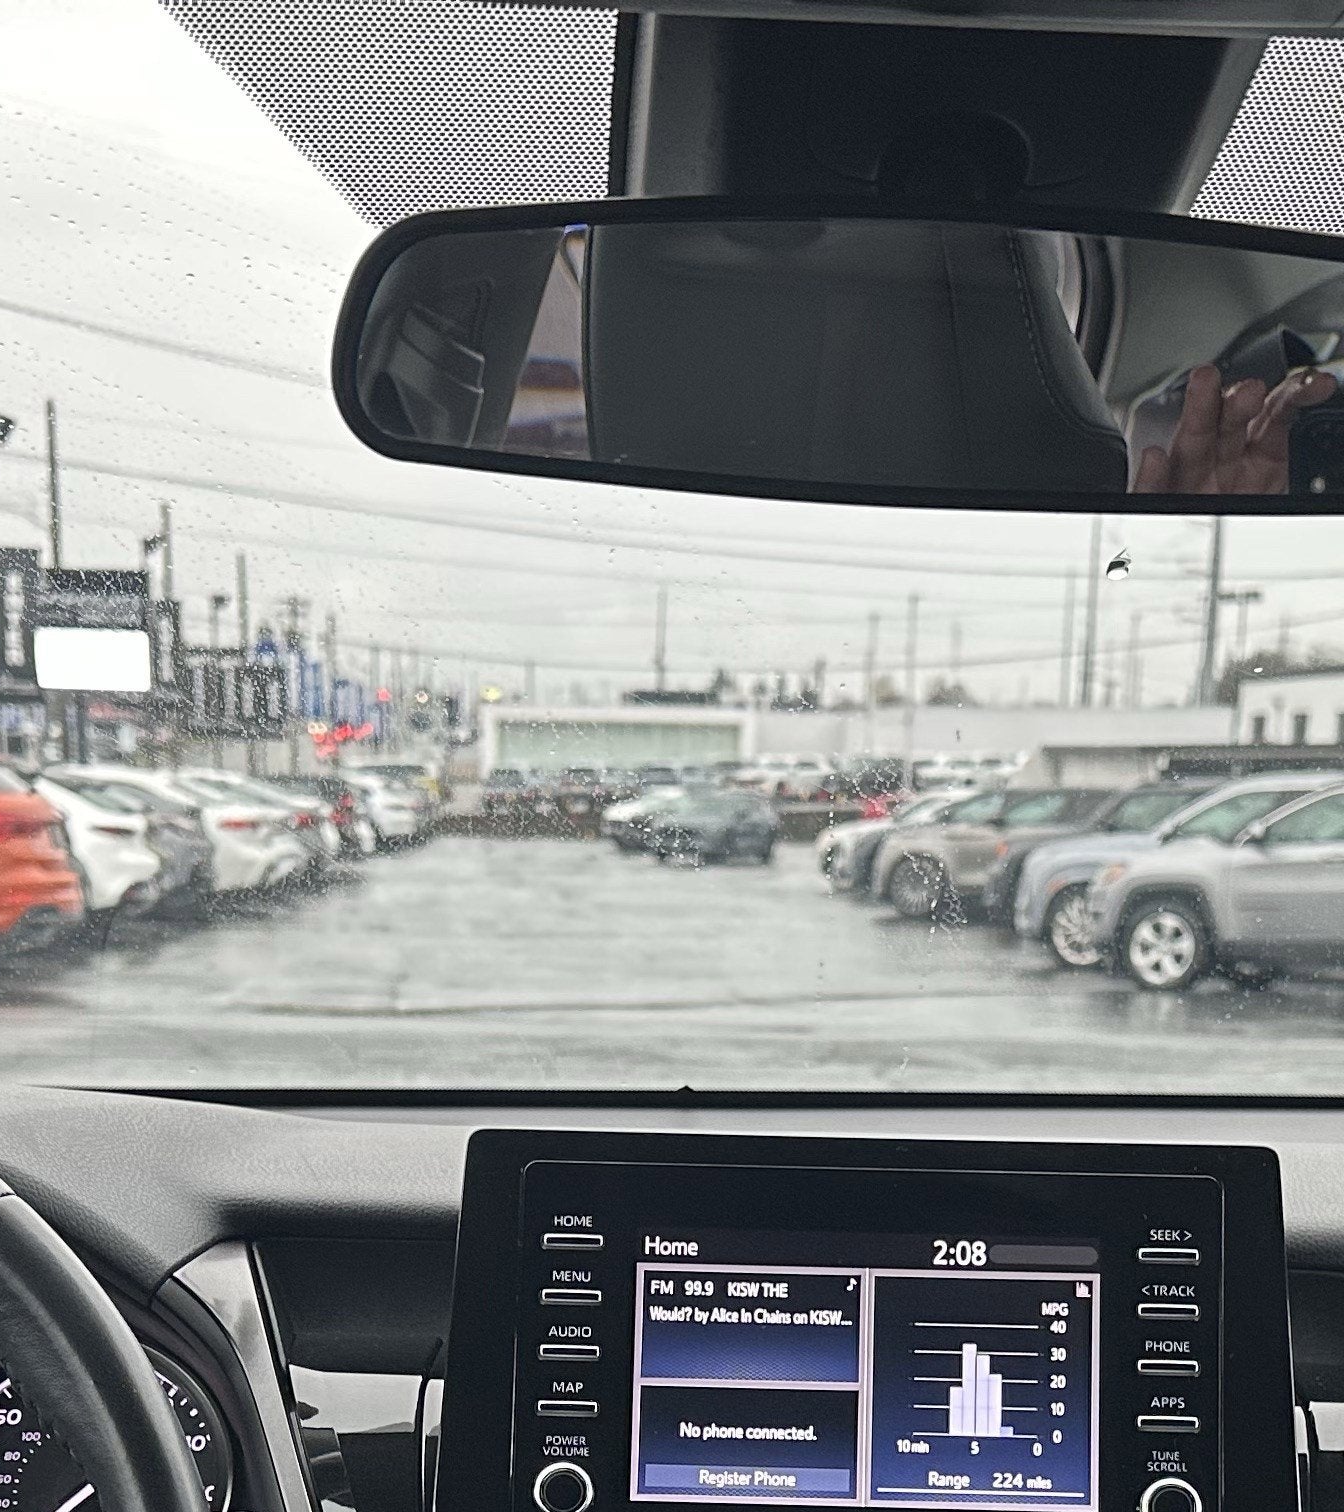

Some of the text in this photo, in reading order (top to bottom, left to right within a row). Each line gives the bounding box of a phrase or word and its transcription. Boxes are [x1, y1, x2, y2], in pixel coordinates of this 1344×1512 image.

[553, 1215, 593, 1227] HOME
[1150, 1230, 1181, 1242] SEEK
[644, 1236, 699, 1256] Home
[932, 1240, 987, 1266] 2:08
[552, 1270, 592, 1282] MENU
[650, 1280, 789, 1298] FM 99.9 KISW THE
[1153, 1285, 1195, 1297] TRACK
[1041, 1302, 1069, 1317] MPG
[649, 1306, 692, 1322] Would?
[694, 1307, 709, 1325] by
[710, 1307, 739, 1324] Alice
[754, 1308, 792, 1325] Chains
[793, 1313, 808, 1326] on
[548, 1326, 592, 1338] AUDIO
[1049, 1320, 1066, 1334] 40
[1145, 1340, 1191, 1352] PHONE
[1049, 1347, 1066, 1361] 30
[552, 1382, 584, 1393] MAP
[1049, 1375, 1066, 1389] 20
[1150, 1397, 1185, 1408] APPS
[1049, 1402, 1066, 1416] 10
[22, 1431, 41, 1443] 100
[679, 1422, 818, 1442] No phone connected.
[1052, 1430, 1063, 1443] 0
[545, 1436, 586, 1446] POWER
[3, 1450, 21, 1461] 80
[542, 1446, 590, 1457] VOLUME
[1032, 1443, 1043, 1457] 0
[1151, 1451, 1180, 1461] TUNE
[1146, 1461, 1188, 1473] SCROLL
[699, 1470, 797, 1487] Register Phone
[927, 1471, 1052, 1490] Range 224 miles
